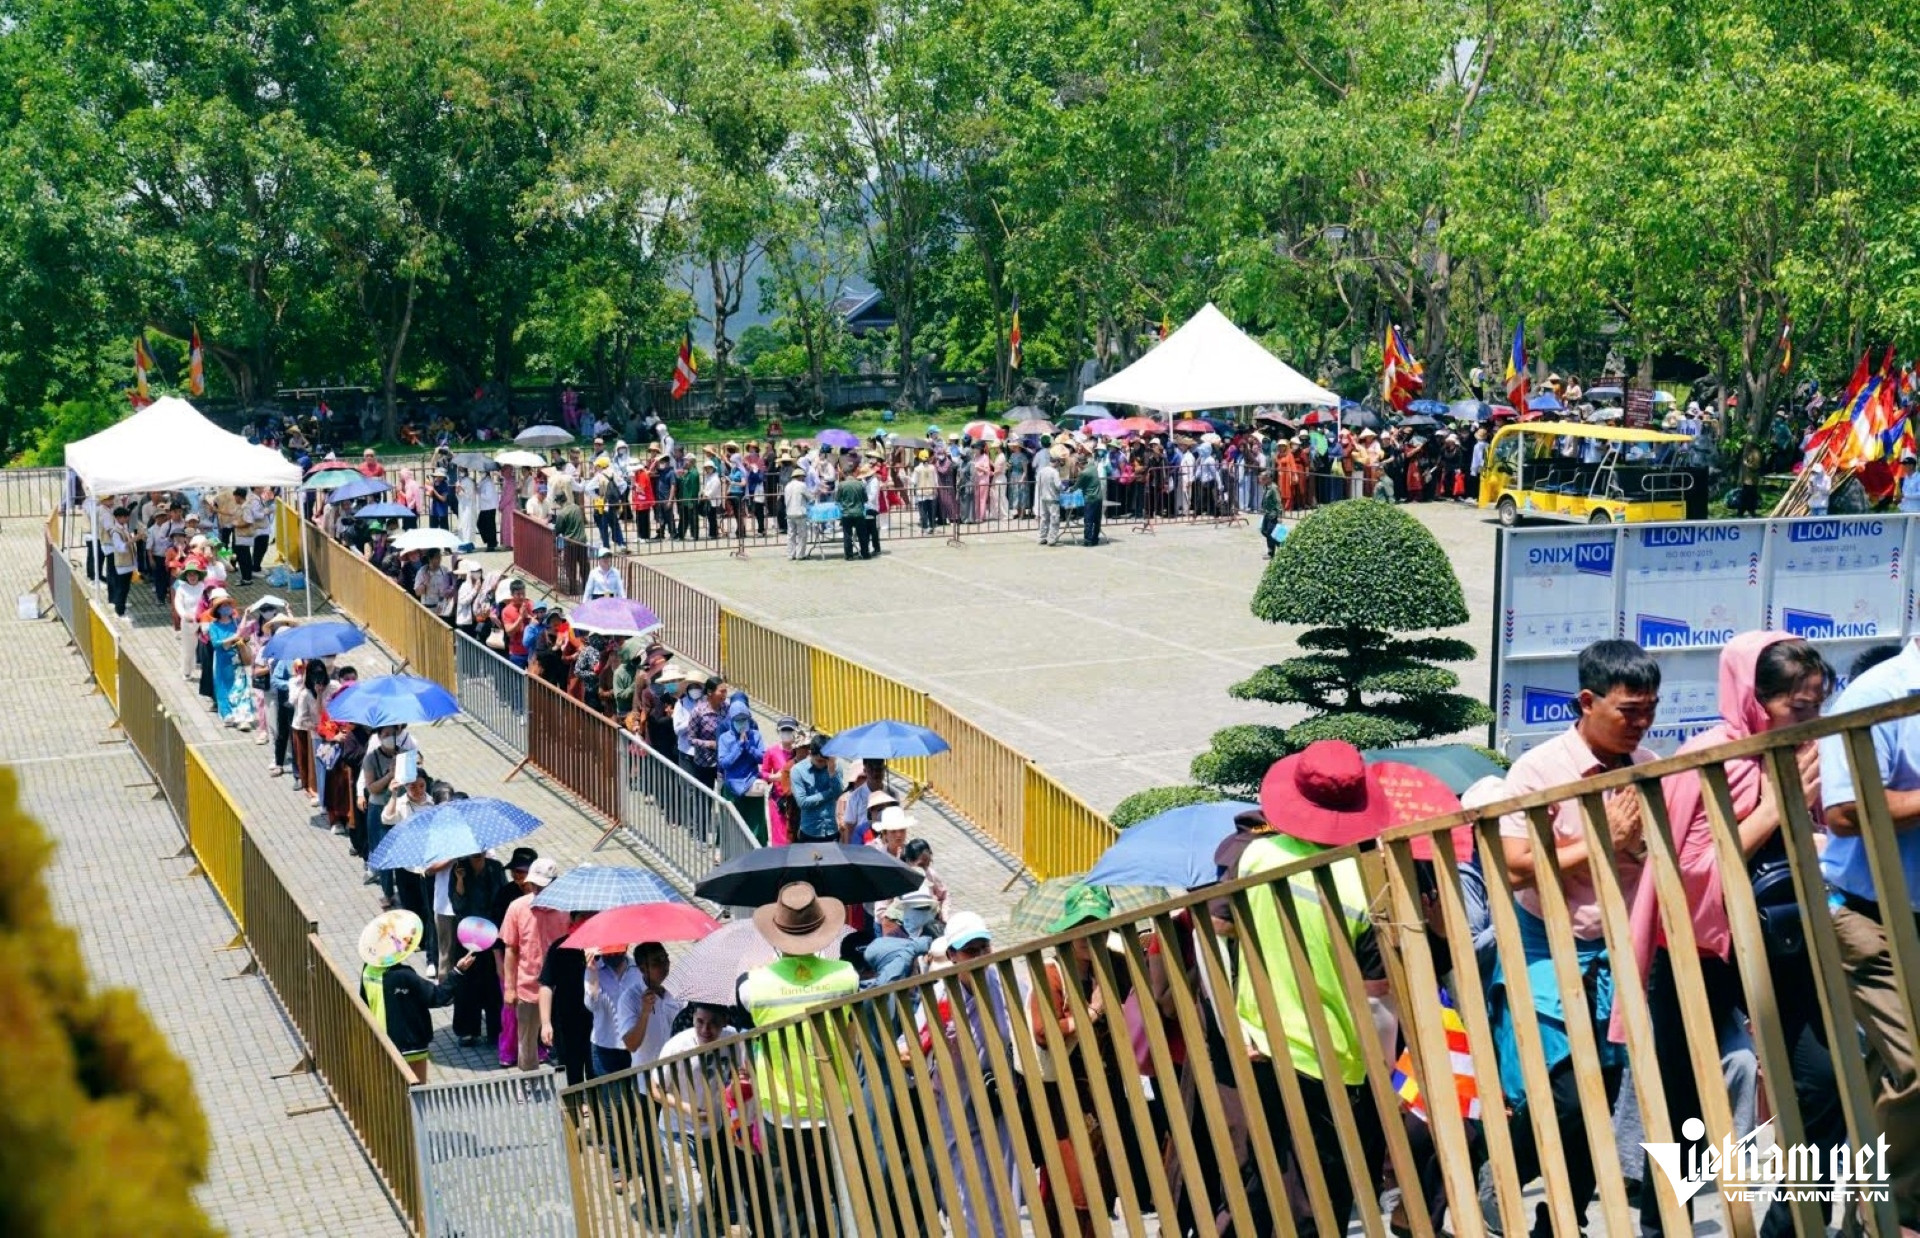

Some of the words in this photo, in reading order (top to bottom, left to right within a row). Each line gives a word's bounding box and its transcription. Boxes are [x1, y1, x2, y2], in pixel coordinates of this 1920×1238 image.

[1651, 527, 1692, 545] LION
[1697, 525, 1740, 542] KING
[1798, 522, 1837, 540] LION
[1841, 520, 1883, 537] KING
[1529, 546, 1573, 564] KING
[1579, 544, 1614, 562] ION
[1646, 631, 1687, 648] LION
[1692, 628, 1734, 646] KING
[1836, 622, 1877, 639] KING
